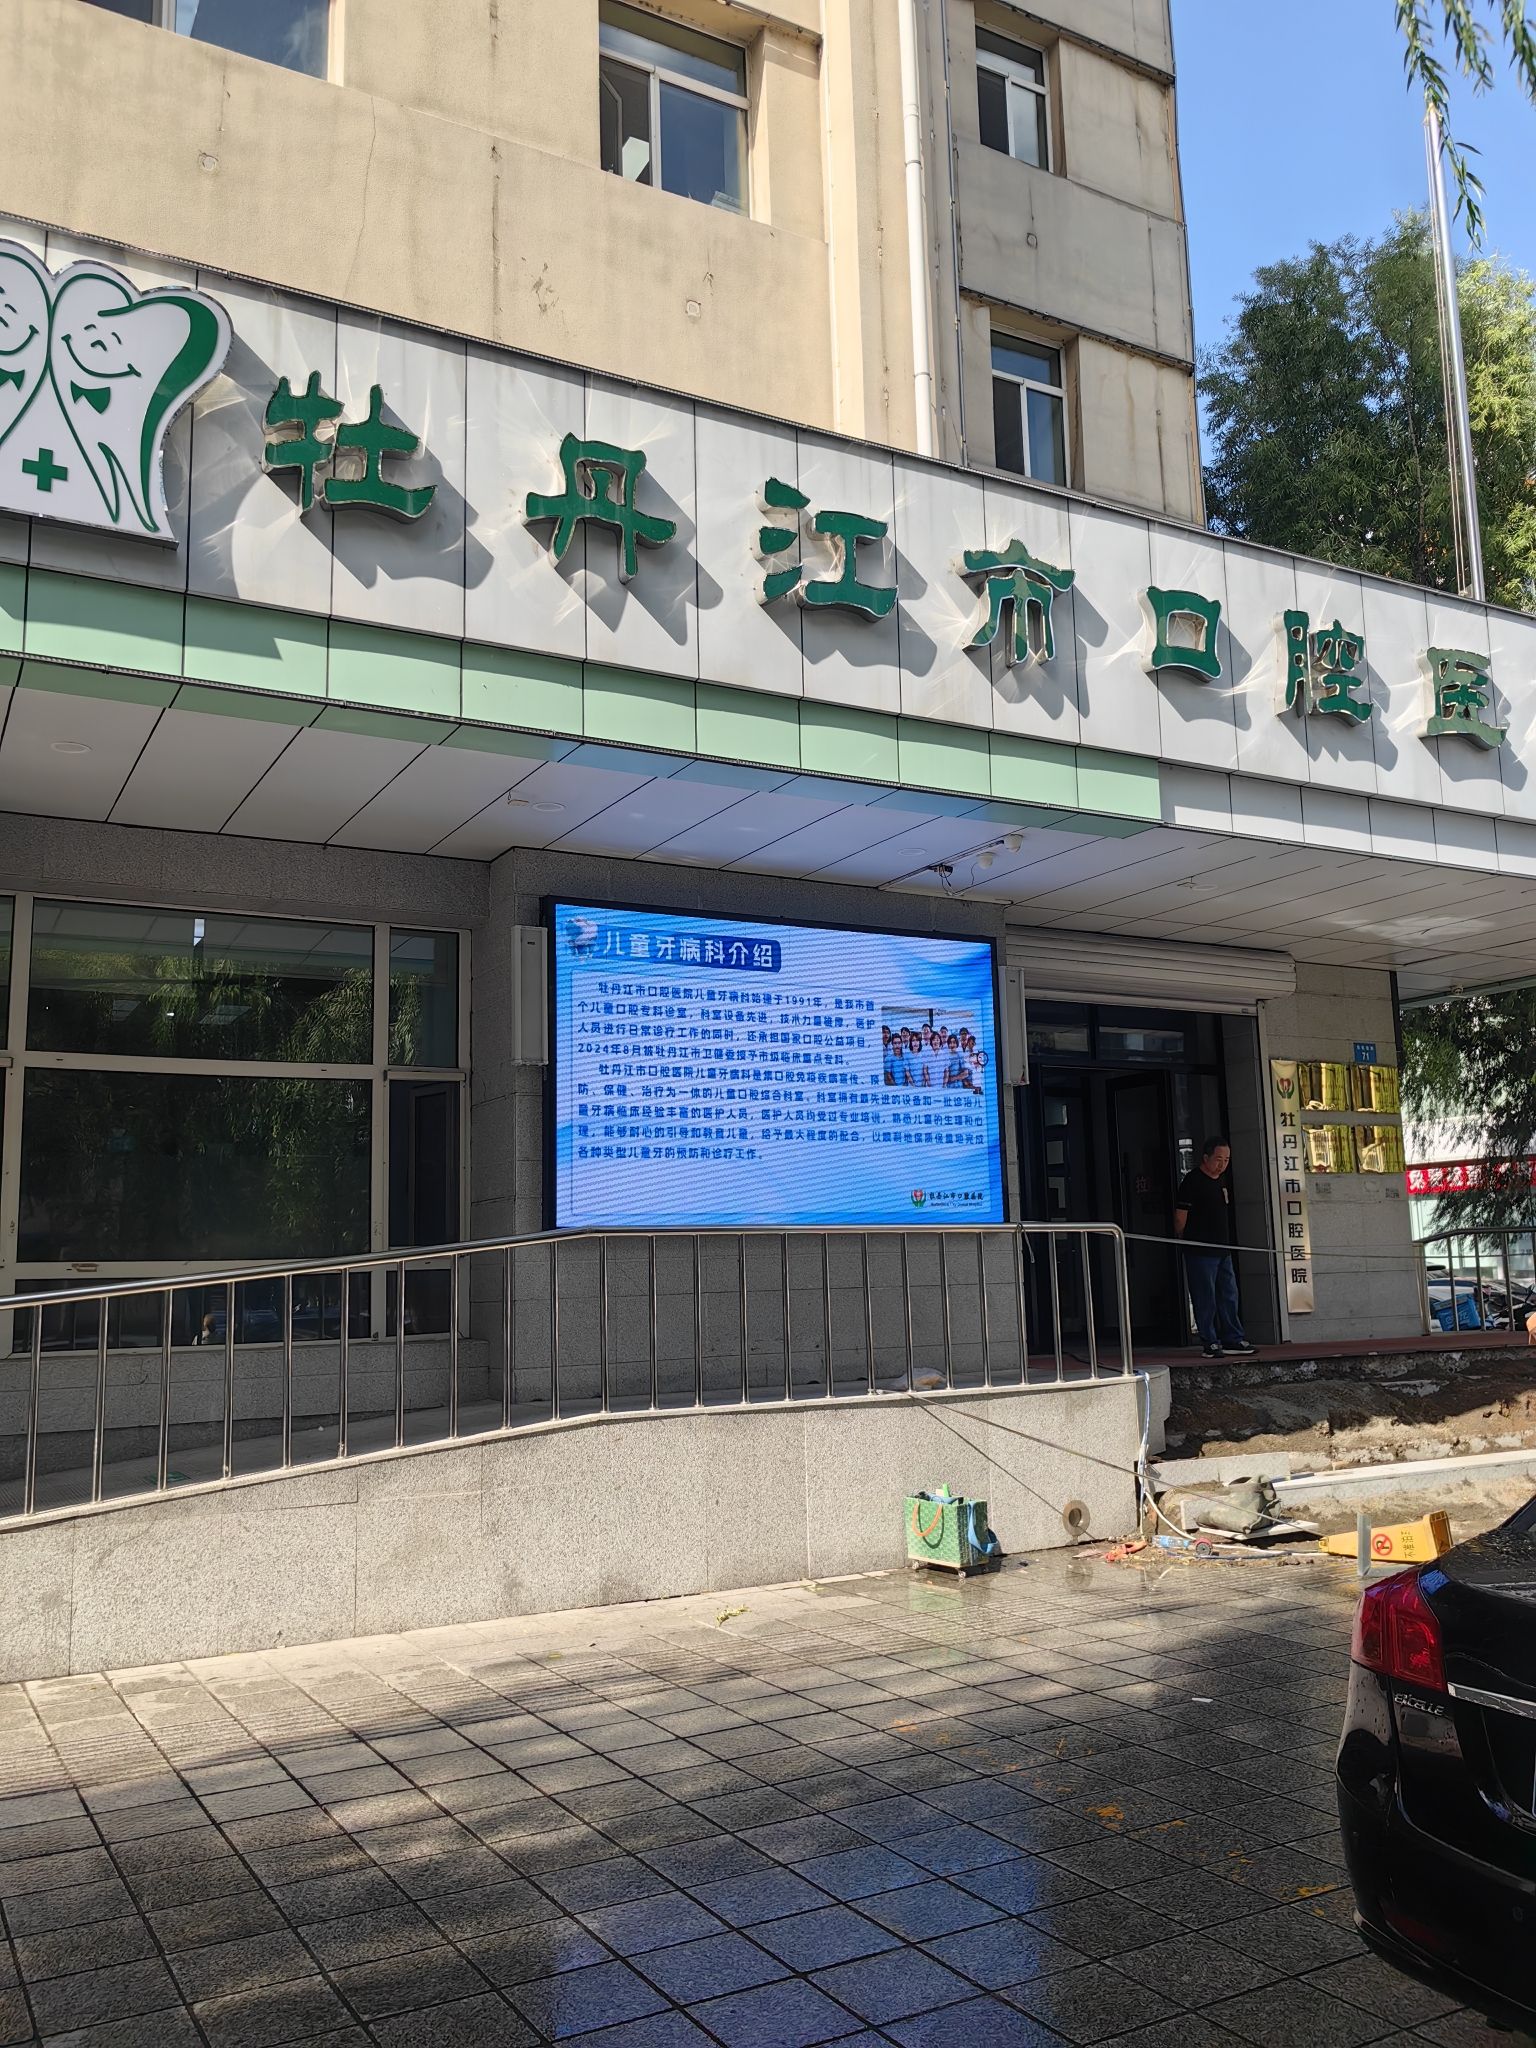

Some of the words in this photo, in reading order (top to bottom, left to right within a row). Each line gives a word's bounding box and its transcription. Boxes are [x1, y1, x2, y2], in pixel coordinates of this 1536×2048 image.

[603, 931, 773, 968] 儿童牙病科介绍
[1280, 1112, 1308, 1284] 牡丹江市口腔医院
